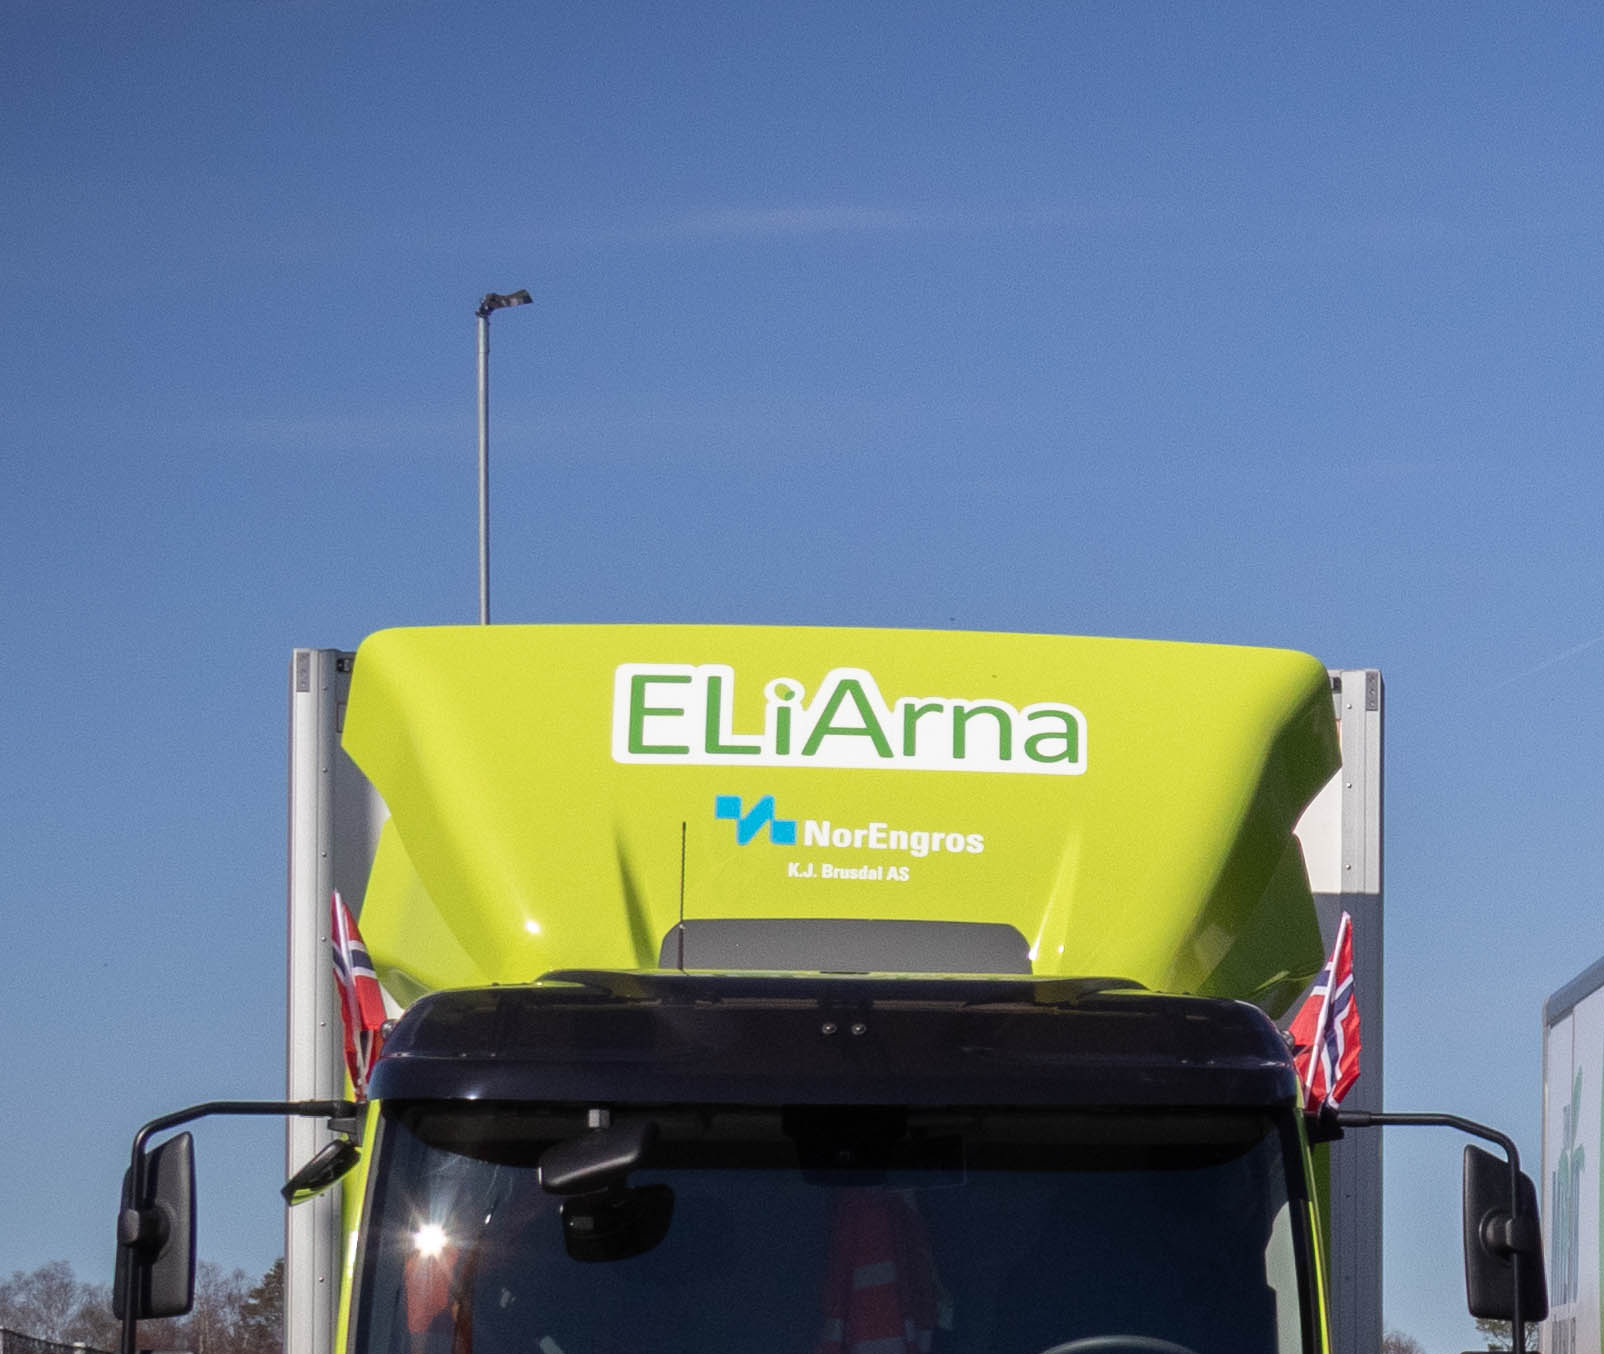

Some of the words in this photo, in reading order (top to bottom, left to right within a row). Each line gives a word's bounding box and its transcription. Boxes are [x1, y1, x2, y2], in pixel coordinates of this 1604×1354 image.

[628, 674, 1079, 763] ELiArna
[803, 820, 985, 857] NorEngros
[788, 863, 818, 878] K.J.
[821, 864, 884, 881] Brusdal
[887, 866, 910, 881] AS
